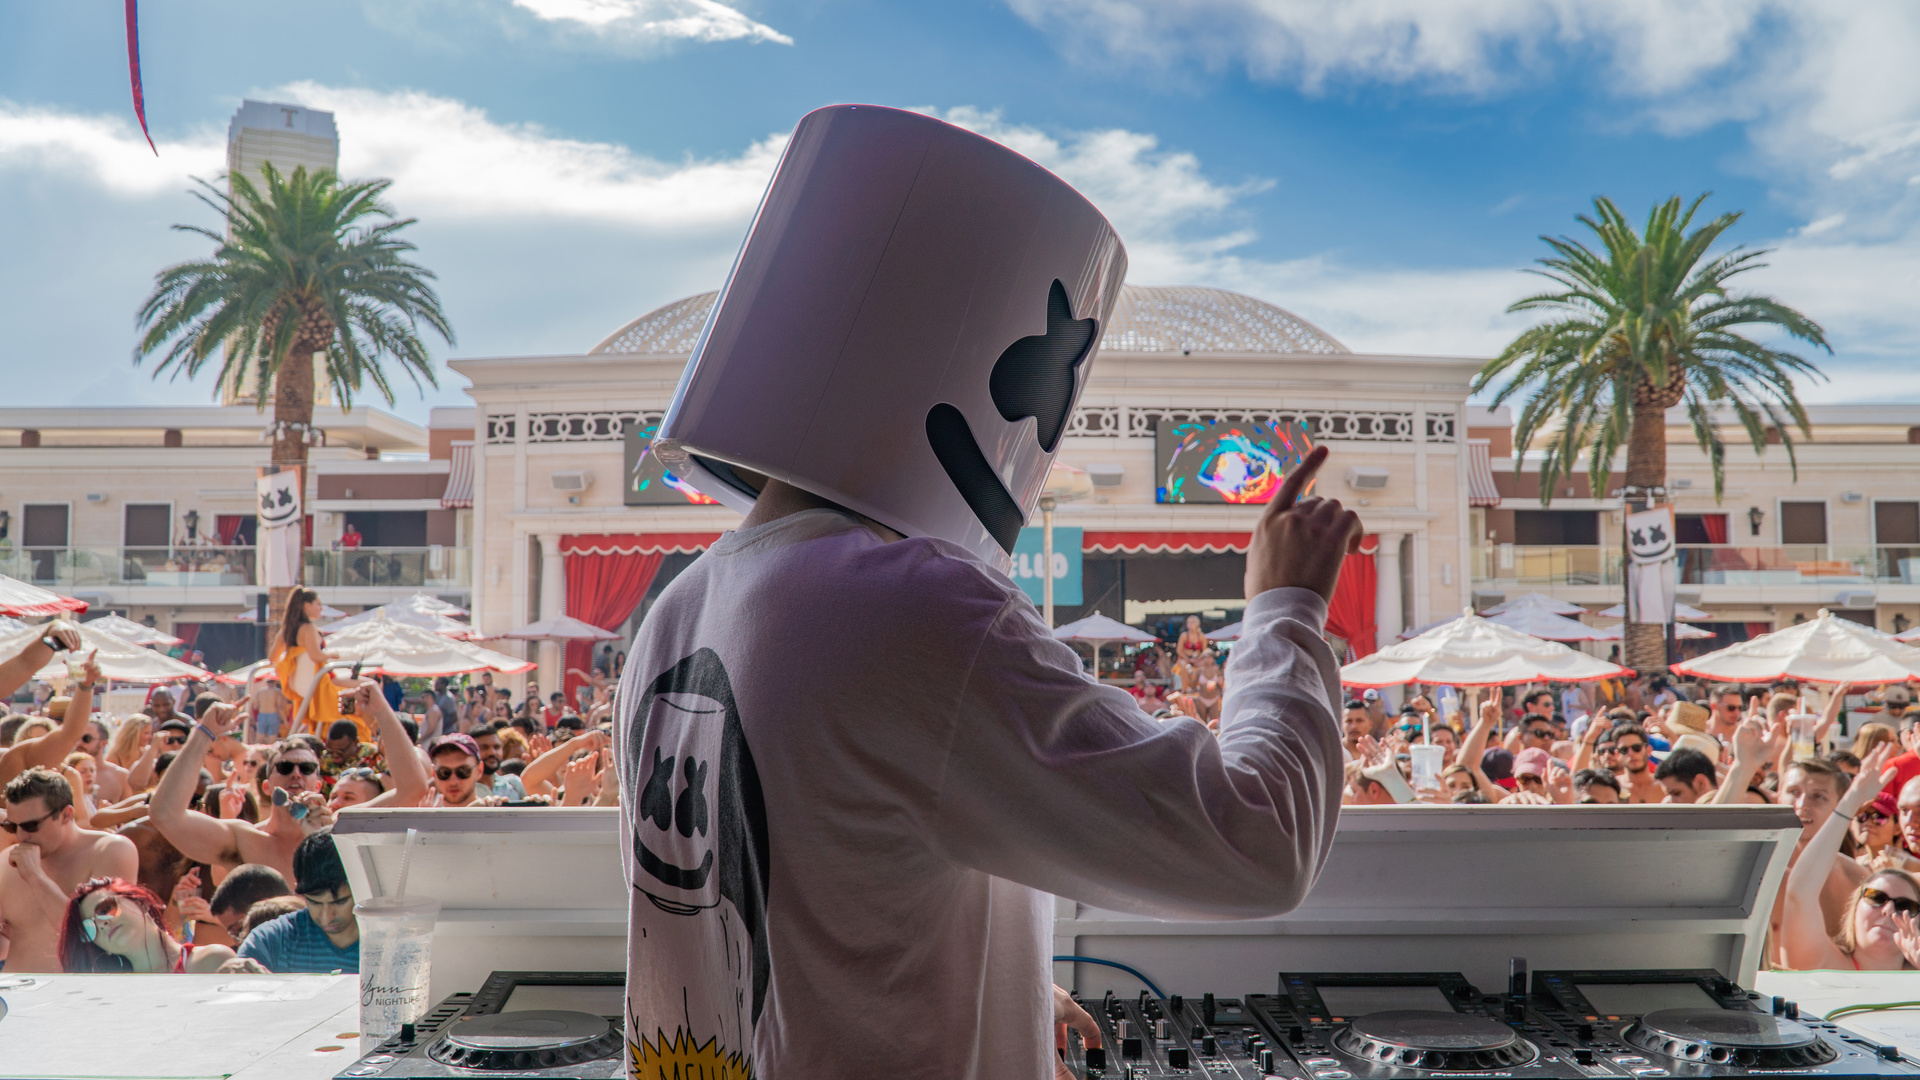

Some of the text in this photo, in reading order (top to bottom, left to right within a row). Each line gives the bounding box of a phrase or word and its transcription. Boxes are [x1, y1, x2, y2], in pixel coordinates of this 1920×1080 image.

[281, 108, 299, 128] T
[1008, 551, 1069, 579] ELLO
[375, 995, 421, 1006] NIGHTLIFE
